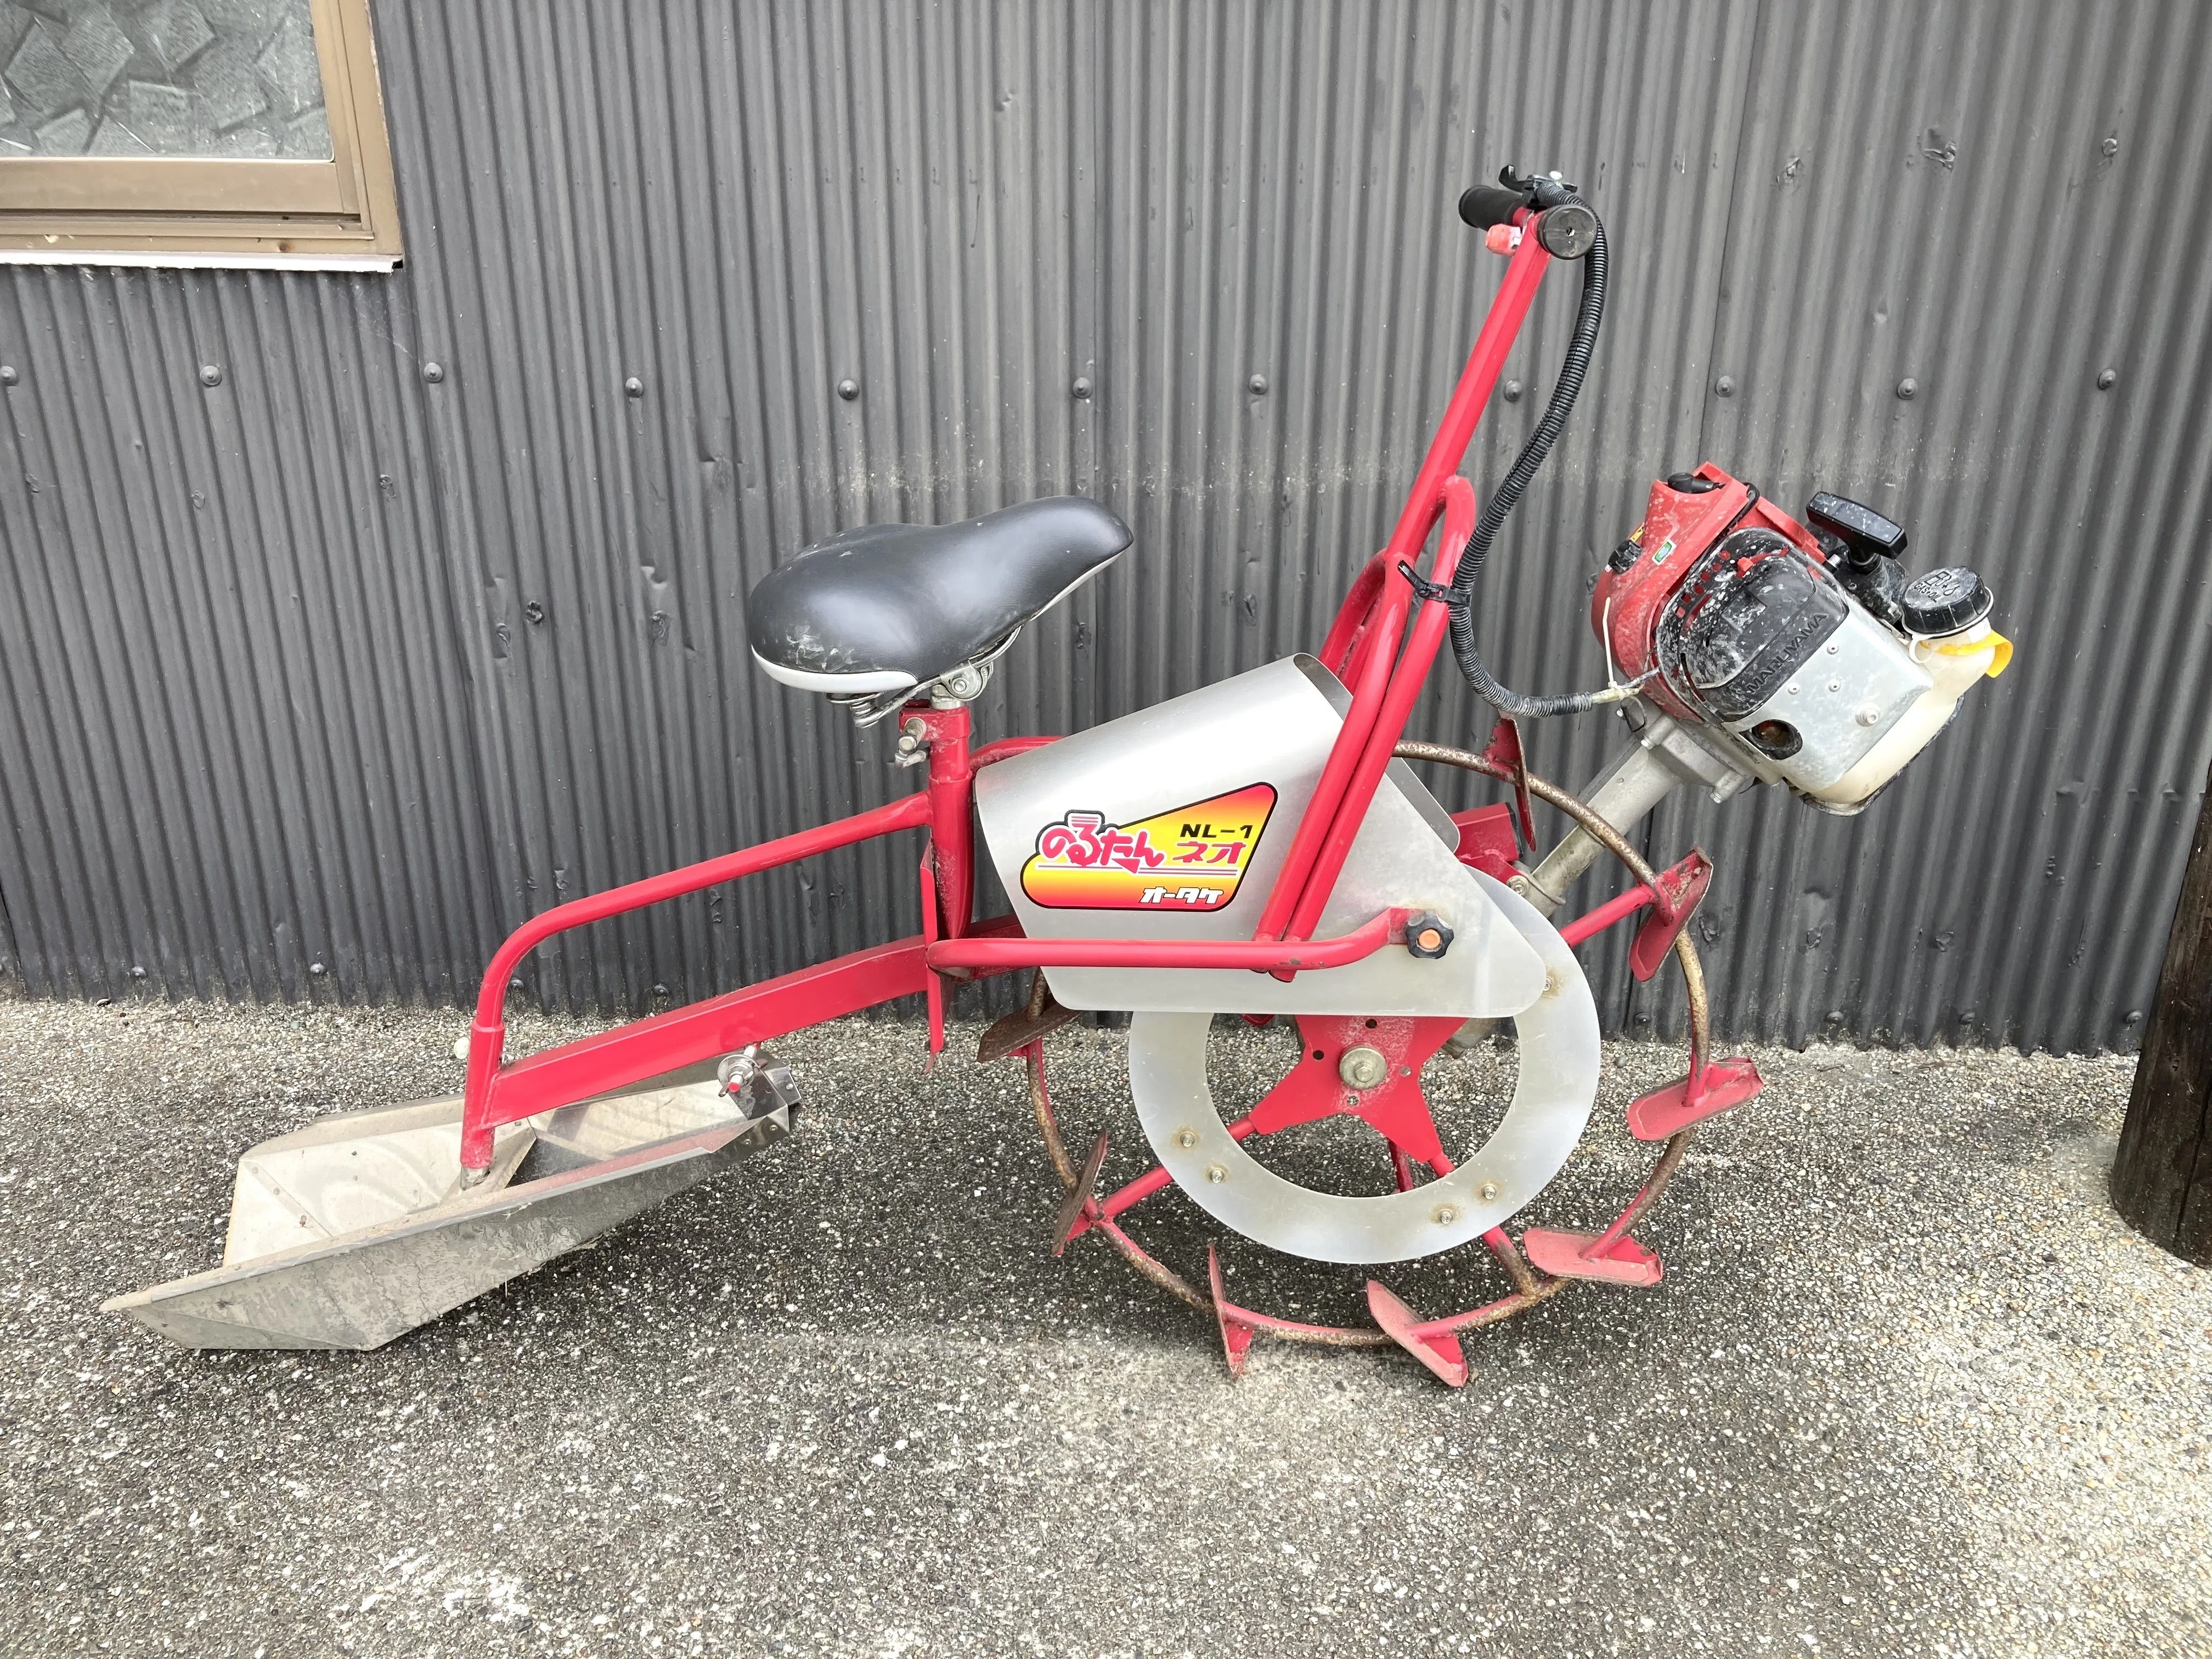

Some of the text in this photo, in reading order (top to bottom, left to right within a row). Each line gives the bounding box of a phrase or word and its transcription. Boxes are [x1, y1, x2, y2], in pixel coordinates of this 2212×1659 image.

[1746, 614, 1828, 693] MARUYAMA
[1042, 822, 1246, 872] のるたん ネオ
[1180, 823, 1253, 839] NL-1
[1138, 886, 1224, 904] オータケ
